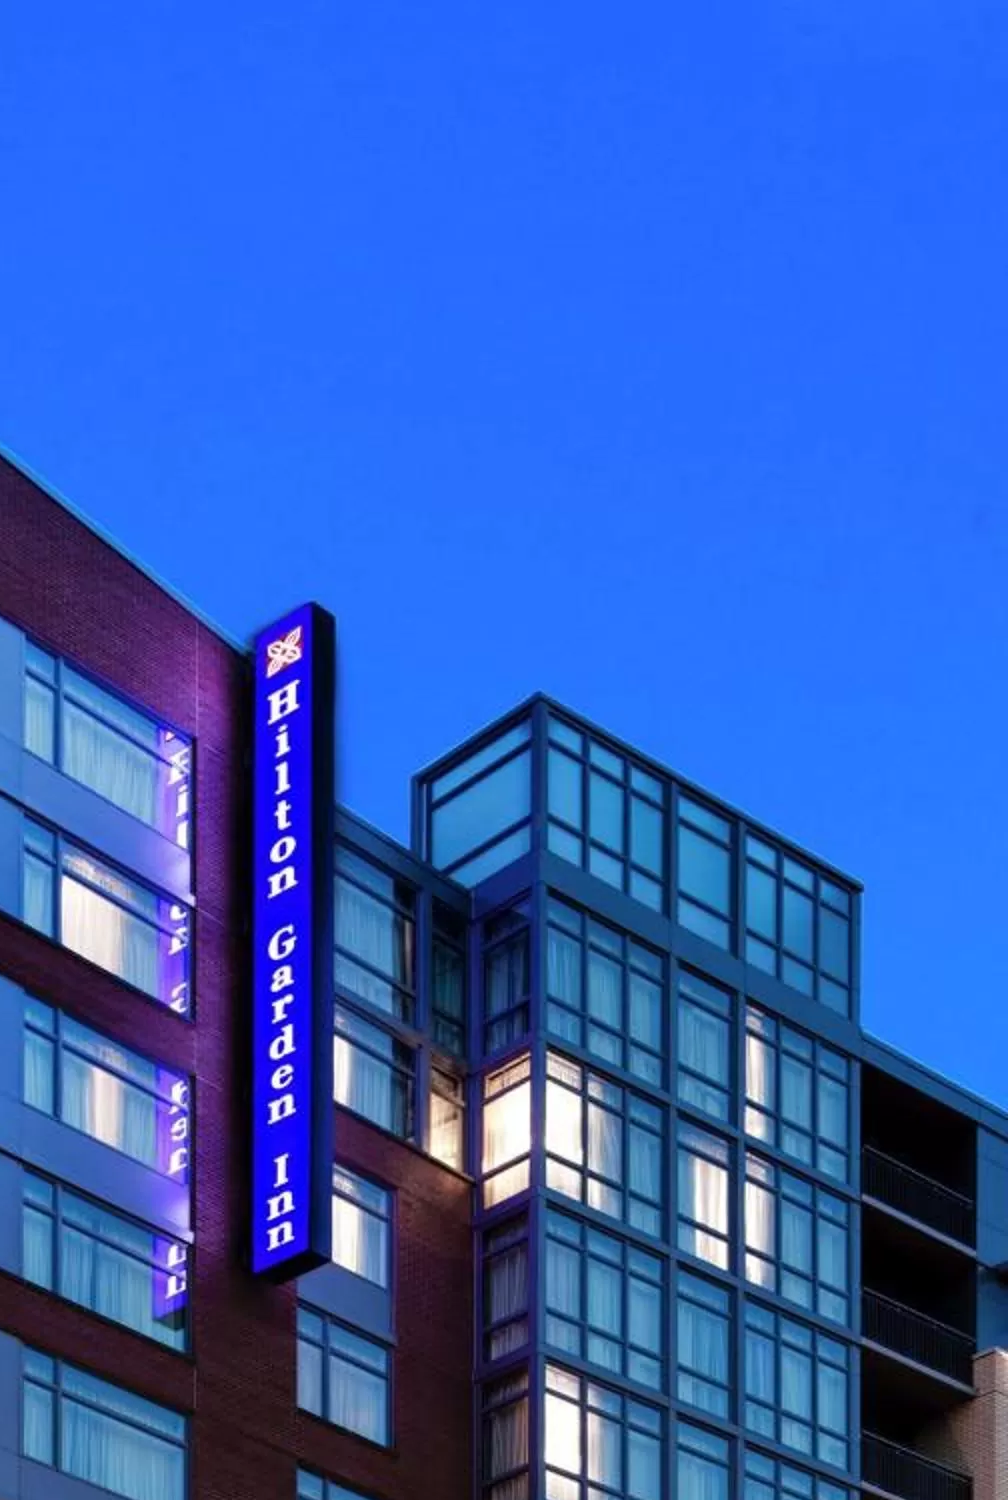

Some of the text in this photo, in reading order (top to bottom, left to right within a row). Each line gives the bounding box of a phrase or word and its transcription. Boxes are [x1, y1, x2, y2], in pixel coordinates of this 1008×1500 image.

[266, 679, 300, 1251] Hilton Garden Inn
